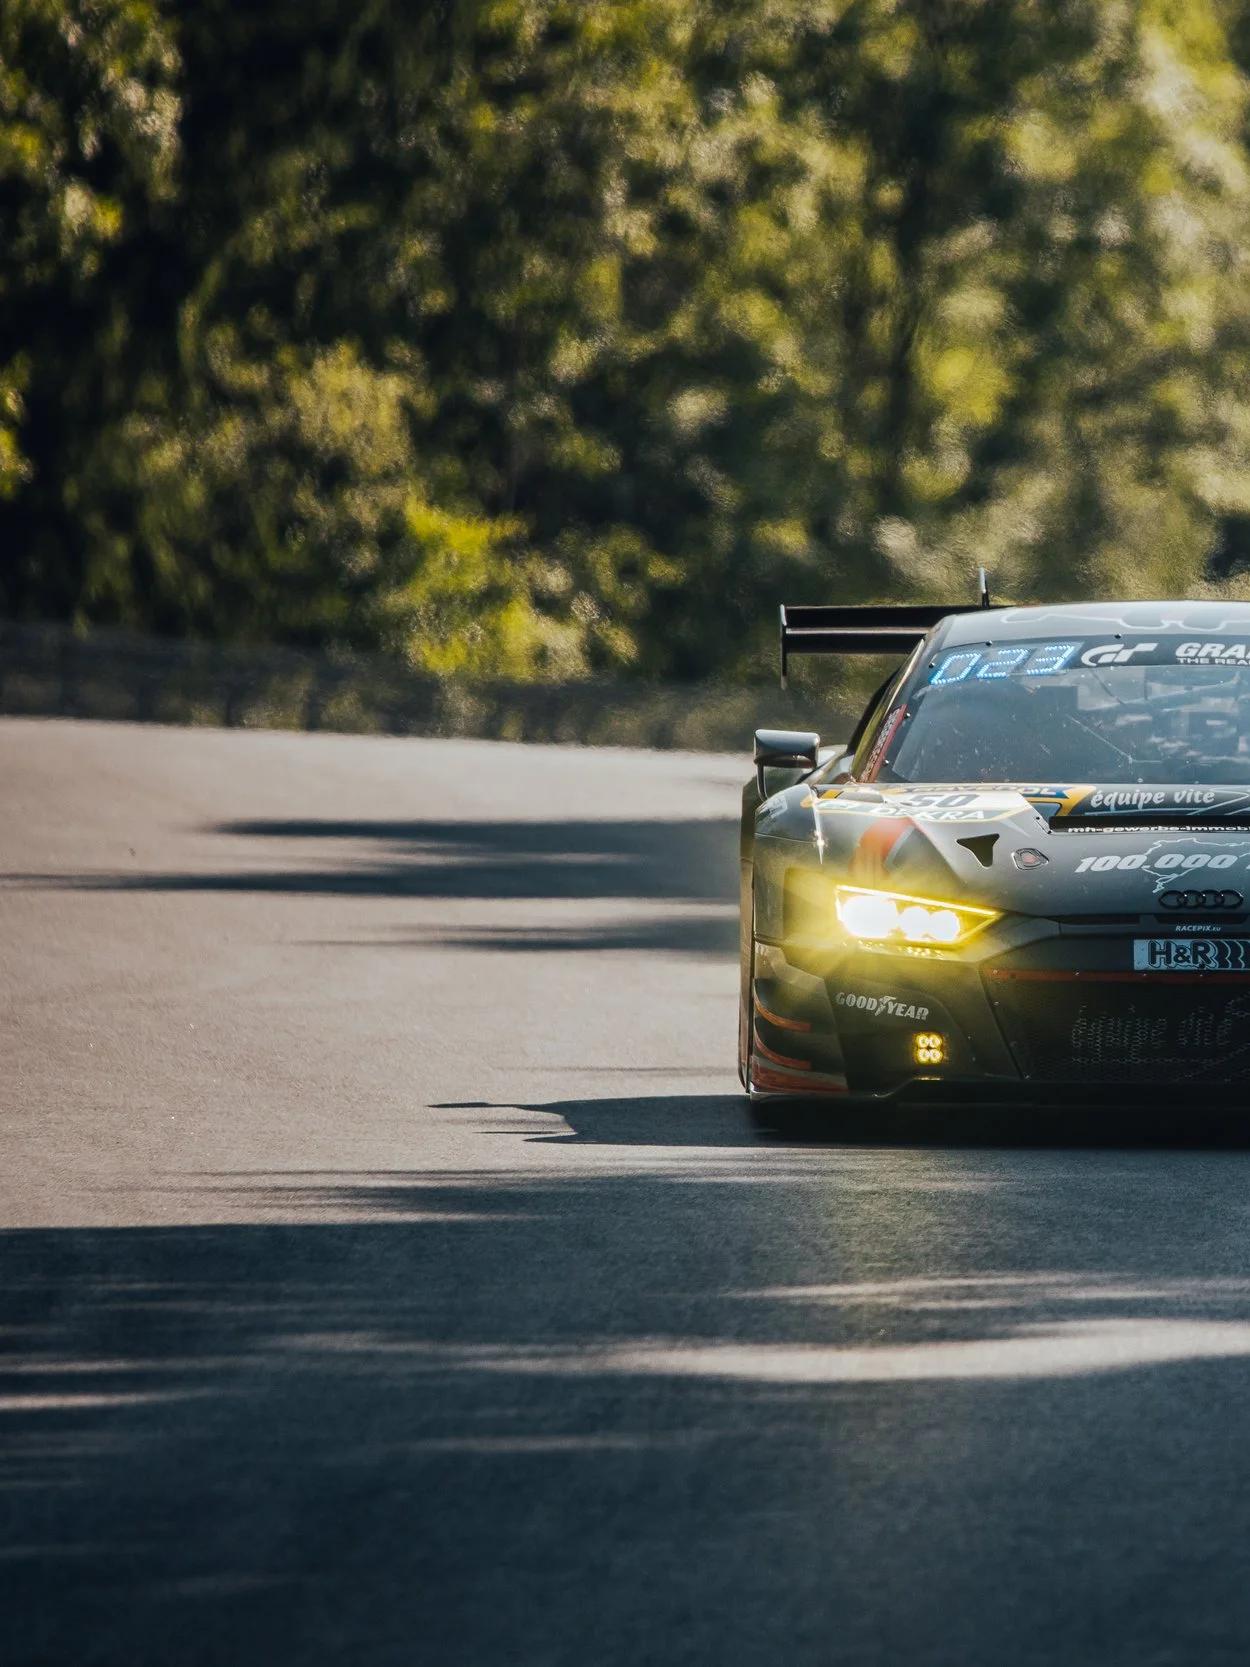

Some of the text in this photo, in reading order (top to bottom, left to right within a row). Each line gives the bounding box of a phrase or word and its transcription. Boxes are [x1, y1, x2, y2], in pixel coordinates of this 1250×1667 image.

[930, 645, 1076, 685] 023
[1176, 657, 1210, 665] THE
[908, 793, 981, 808] 50
[1090, 788, 1165, 812] équipe
[1074, 853, 1240, 873] 100.000
[1147, 940, 1217, 969] H&R
[835, 991, 930, 1021] GOODYEAR
